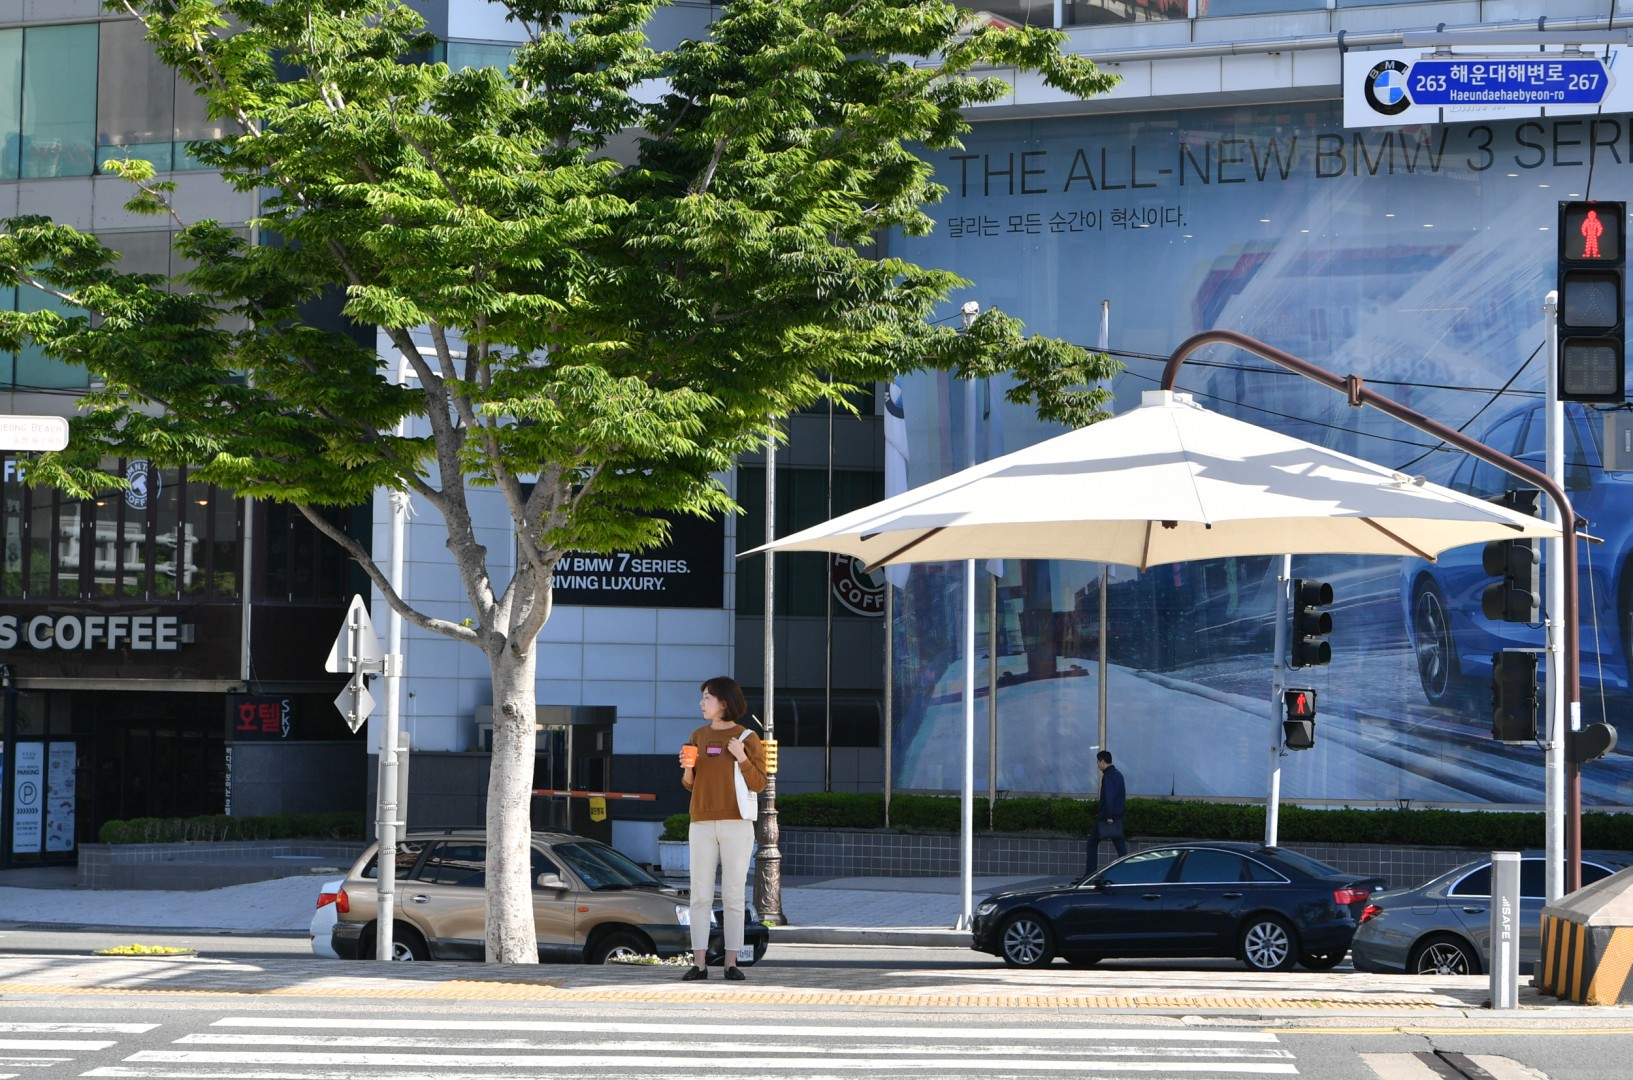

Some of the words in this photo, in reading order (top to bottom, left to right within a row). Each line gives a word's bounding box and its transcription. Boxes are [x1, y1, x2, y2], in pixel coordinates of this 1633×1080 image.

[1416, 75, 1447, 92] 263
[1450, 64, 1565, 86] 해운대해변로
[1568, 74, 1599, 91] 267
[1450, 89, 1565, 103] Haeundaehaebyeon-ro
[949, 150, 1048, 198] THE
[1063, 136, 1299, 193] ALL-NEW
[1315, 129, 1449, 178] BMW
[1466, 124, 1494, 172] 3
[948, 214, 1001, 239] 달리는
[1006, 212, 1042, 235] 모든
[1048, 209, 1103, 233] 순간이
[1109, 205, 1188, 231] 혁신이다.
[31, 422, 62, 433] BEACH
[124, 490, 147, 507] COFF
[573, 558, 613, 572] BMW
[617, 553, 631, 573] 7
[631, 559, 691, 573] SERIES.
[602, 576, 666, 591] LUXURY.
[839, 578, 884, 608] COFF
[27, 615, 178, 650] COFFEE
[238, 703, 281, 732] 호텔
[281, 699, 291, 738] Sky
[1501, 906, 1511, 940] SAFE
